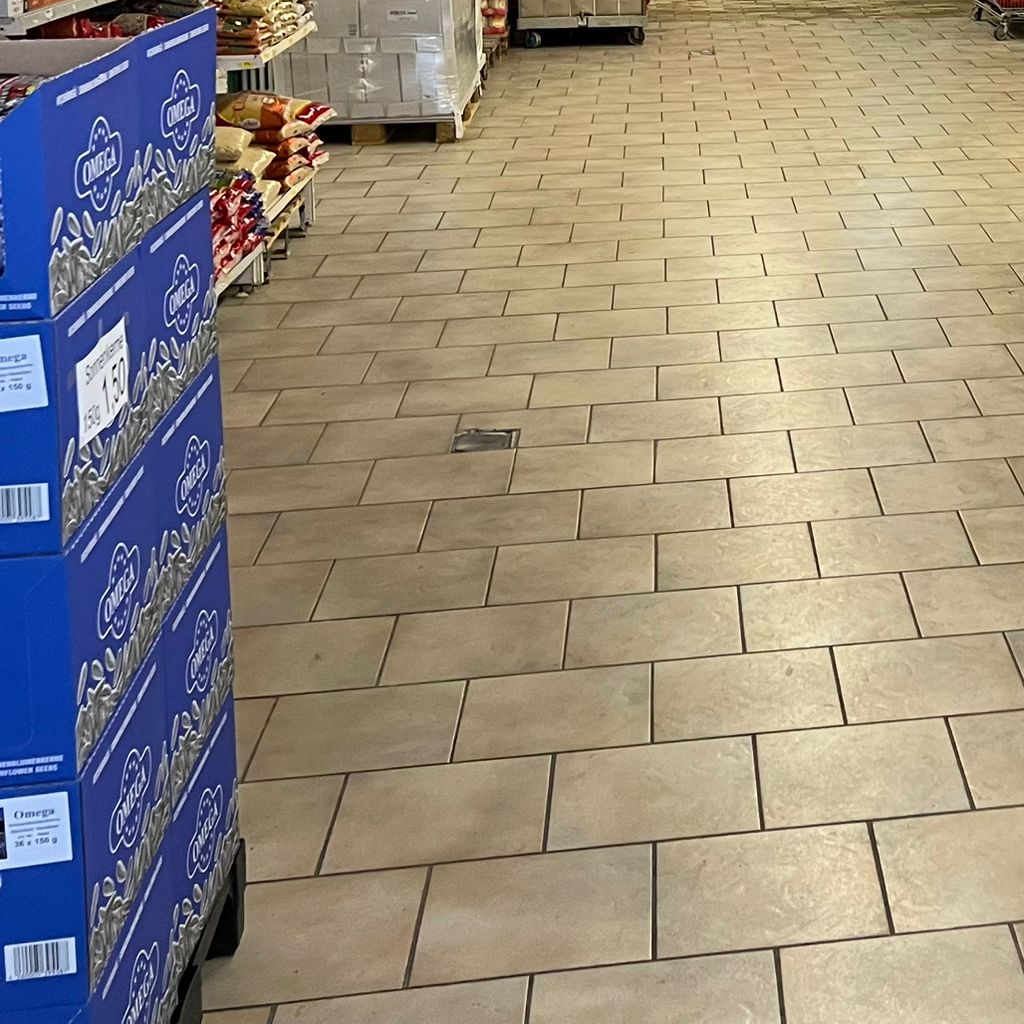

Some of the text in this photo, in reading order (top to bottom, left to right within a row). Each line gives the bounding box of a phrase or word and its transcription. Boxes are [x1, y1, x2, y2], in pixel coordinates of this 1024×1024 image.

[167, 95, 196, 128] OMEGA
[82, 144, 117, 186] OMEGA
[168, 275, 196, 316] OMEGA
[0, 353, 27, 363] mega
[180, 453, 206, 501] OMEGA
[104, 562, 135, 623] OMEGA
[190, 628, 215, 679] OMEGA
[14, 808, 55, 820] Omega
[116, 763, 148, 834] OMEGA
[192, 800, 219, 863] OMEGA
